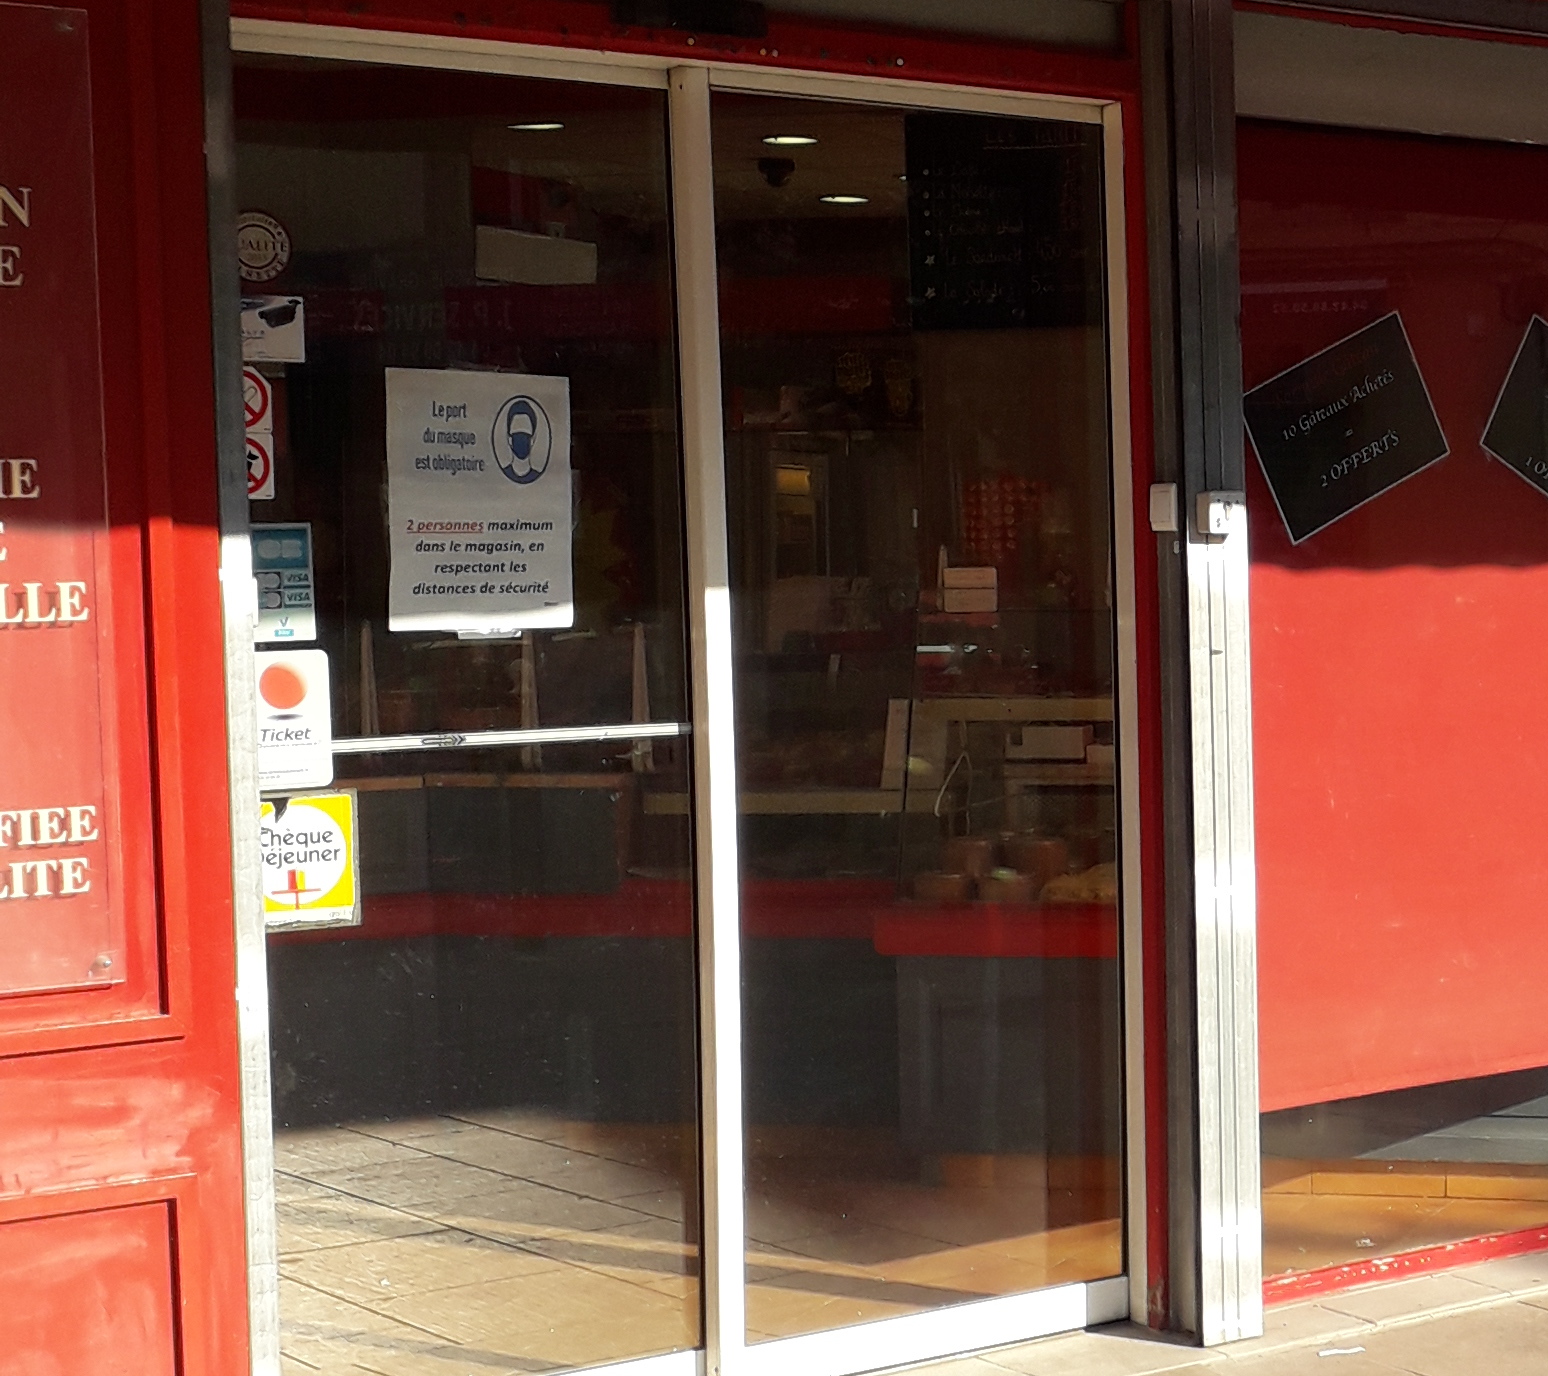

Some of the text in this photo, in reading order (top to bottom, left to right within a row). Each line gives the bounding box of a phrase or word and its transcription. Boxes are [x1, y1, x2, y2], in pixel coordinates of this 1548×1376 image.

[432, 401, 467, 422] Le port
[423, 427, 476, 449] du masque
[415, 455, 485, 475] est obligatoire
[1320, 429, 1400, 487] 2 OFFERTS
[406, 520, 553, 534] 2 personnes maximum
[415, 540, 545, 554] dans le magasin, en
[434, 561, 527, 576] respectant les
[287, 574, 309, 583] VISA
[412, 581, 549, 595] distances de sécurité
[287, 593, 309, 602] VISA
[260, 728, 311, 742] Ticket
[261, 827, 333, 848] Chèque
[261, 848, 341, 869] éjeuner
[0, 857, 91, 899] ITE
